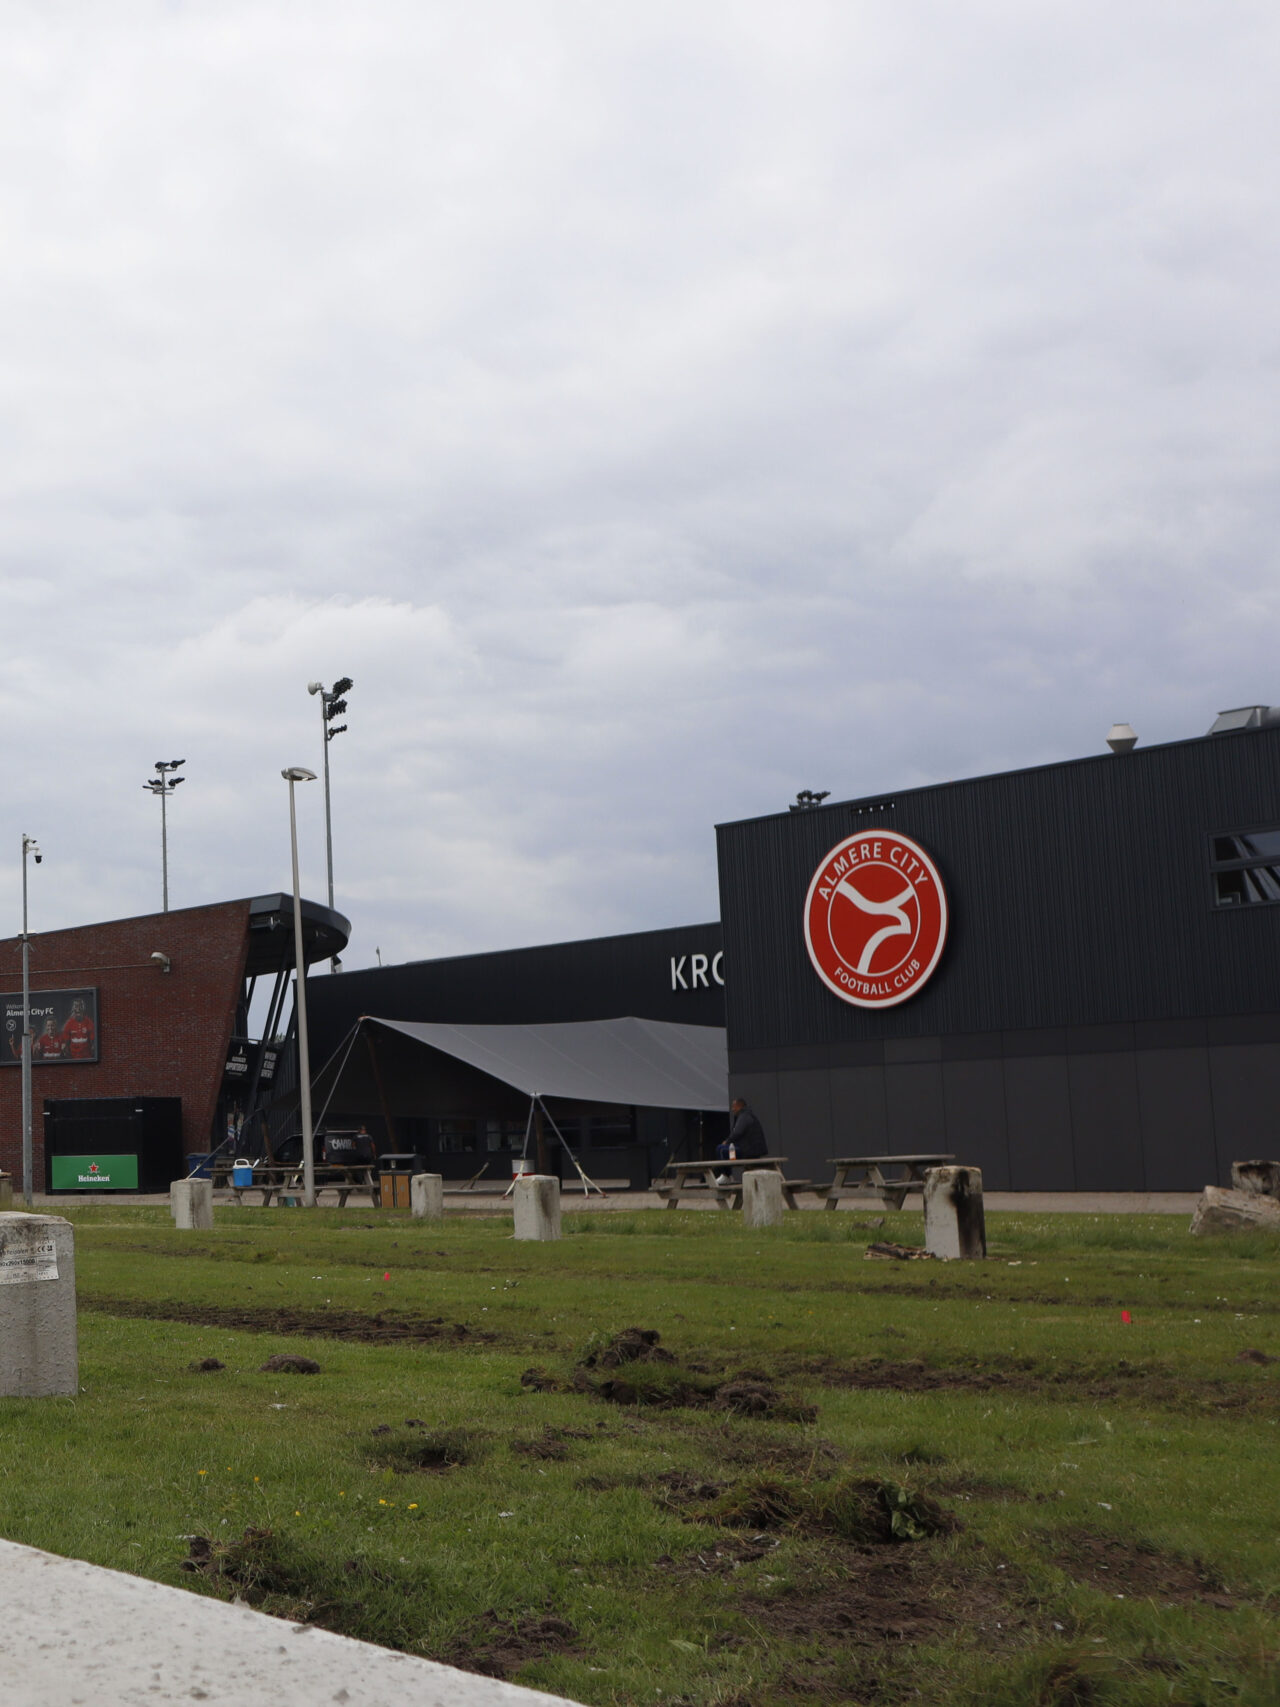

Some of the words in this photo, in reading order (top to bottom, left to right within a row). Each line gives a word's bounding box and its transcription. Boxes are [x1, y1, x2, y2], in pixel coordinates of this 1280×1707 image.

[818, 842, 882, 900] ALMERE
[889, 846, 928, 885] CITY
[834, 966, 892, 995] FOOTBALL
[893, 958, 921, 988] CLUB
[6, 1009, 30, 1017] Alme
[31, 1008, 45, 1017] City
[45, 1007, 54, 1015] FC
[78, 1174, 110, 1182] Heineken
